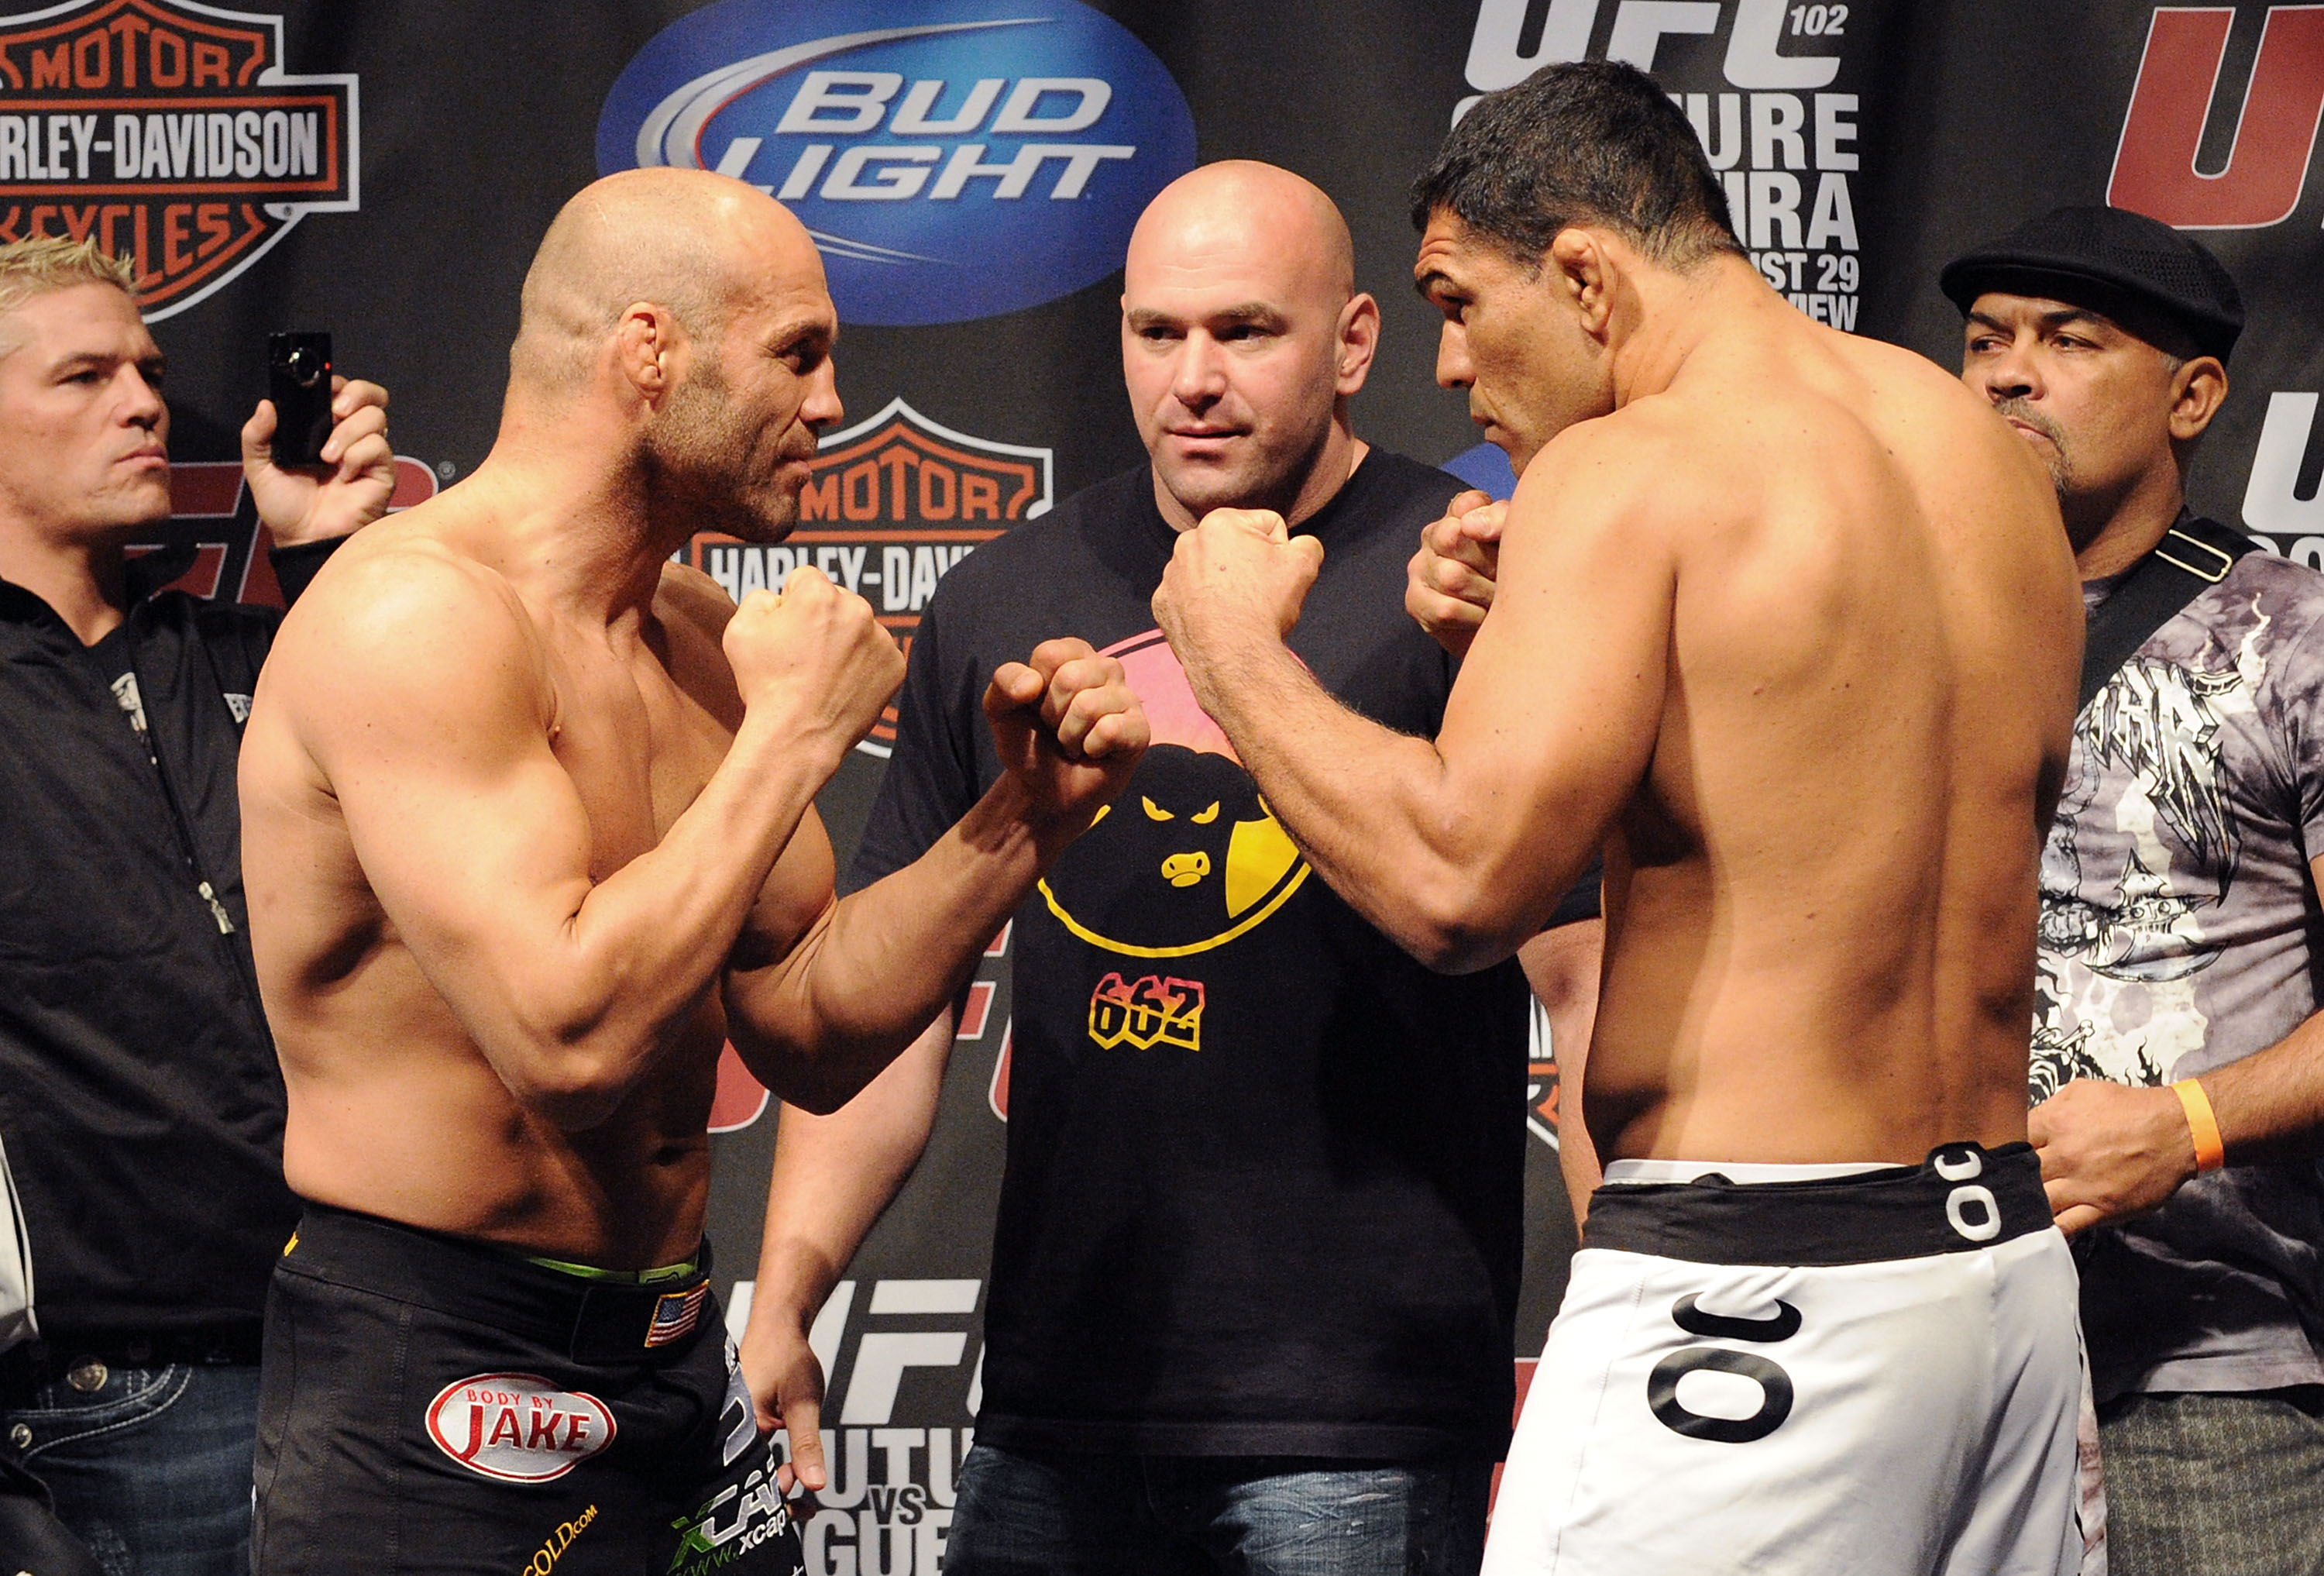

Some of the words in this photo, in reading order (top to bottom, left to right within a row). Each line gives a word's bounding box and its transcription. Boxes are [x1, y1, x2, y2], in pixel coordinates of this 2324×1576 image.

[32, 12, 230, 89] MOTOR
[1790, 4, 1848, 36] 102
[776, 71, 1112, 135] BUD
[714, 137, 1136, 201] LIGHT
[799, 444, 1000, 521] MOTOR
[466, 1388, 521, 1406] BODY
[531, 1396, 553, 1409] BY
[457, 1402, 591, 1463] JAKE
